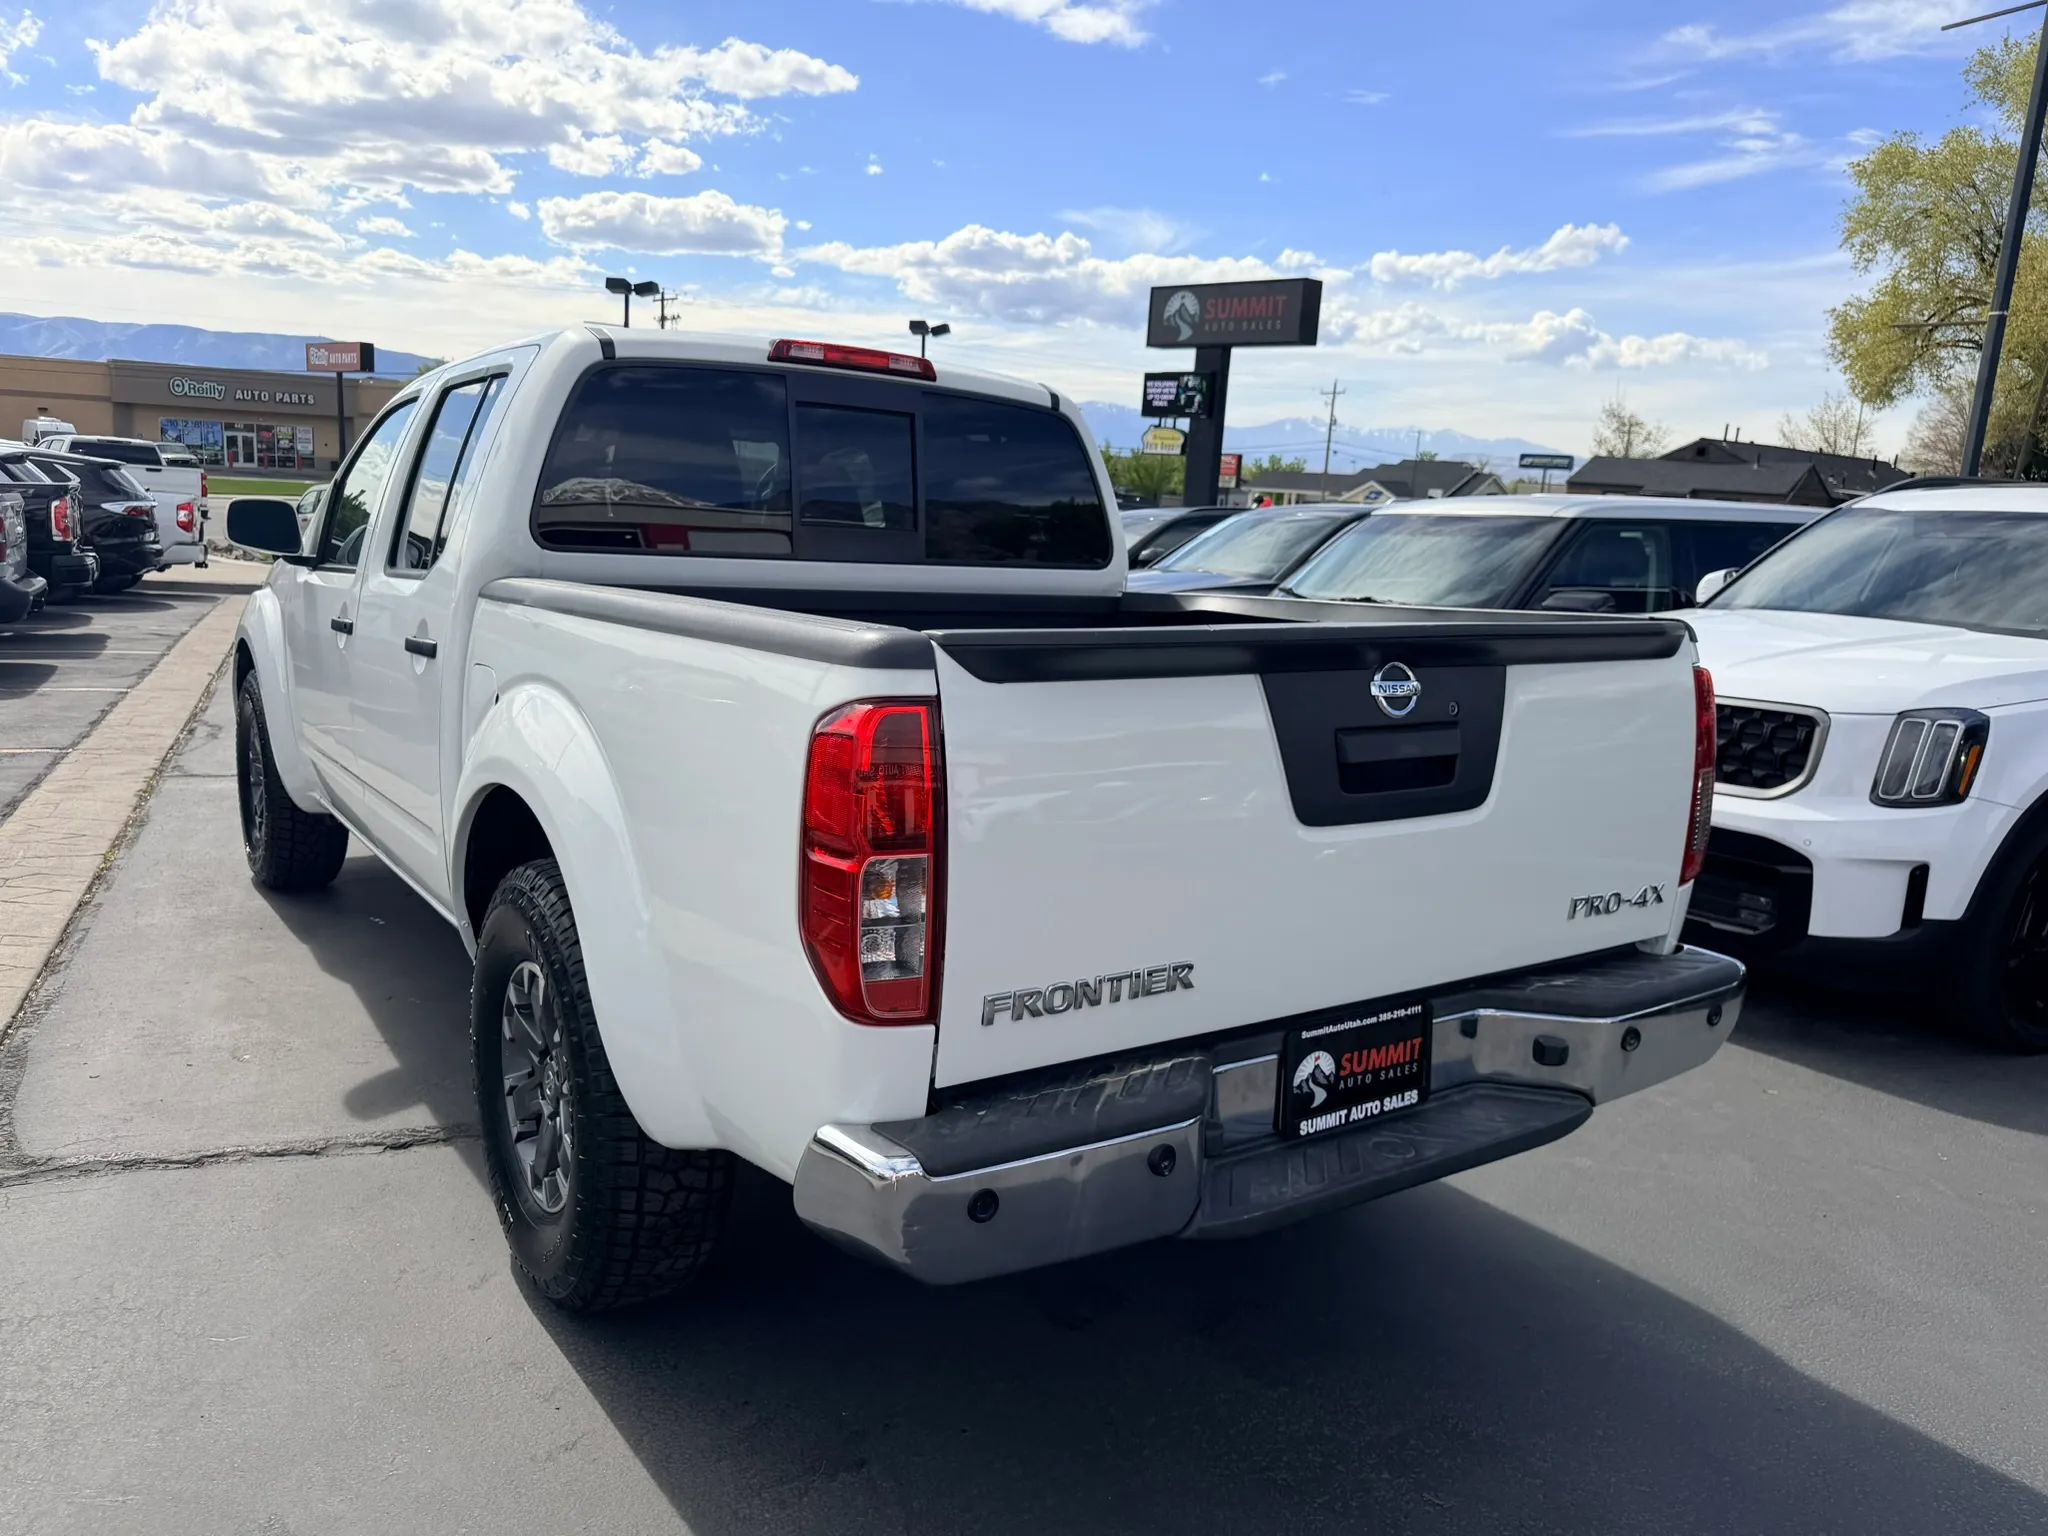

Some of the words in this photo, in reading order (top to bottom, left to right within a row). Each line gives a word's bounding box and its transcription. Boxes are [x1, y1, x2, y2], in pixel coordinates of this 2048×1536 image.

[1205, 295, 1288, 320] SUMMIT
[1204, 321, 1235, 332] AUTO
[1241, 320, 1281, 331] SALES
[329, 352, 341, 364] AUTO
[342, 352, 357, 364] PARTS
[170, 377, 226, 400] O'Reilly
[235, 389, 269, 402] AUTO
[276, 392, 315, 405] PARTS
[1378, 684, 1419, 694] NISSAN
[1567, 882, 1664, 920] PRO-4X
[981, 960, 1195, 1026] FRONTIER
[1301, 1015, 1378, 1039] SummitAutoUtah.com
[1339, 1037, 1423, 1077] SUMMIT
[1339, 1073, 1372, 1090] AUTO
[1380, 1062, 1418, 1080] SALES
[1300, 1109, 1348, 1136] SUMMIT
[1349, 1100, 1381, 1122] AUTO
[1383, 1089, 1418, 1112] SALES
